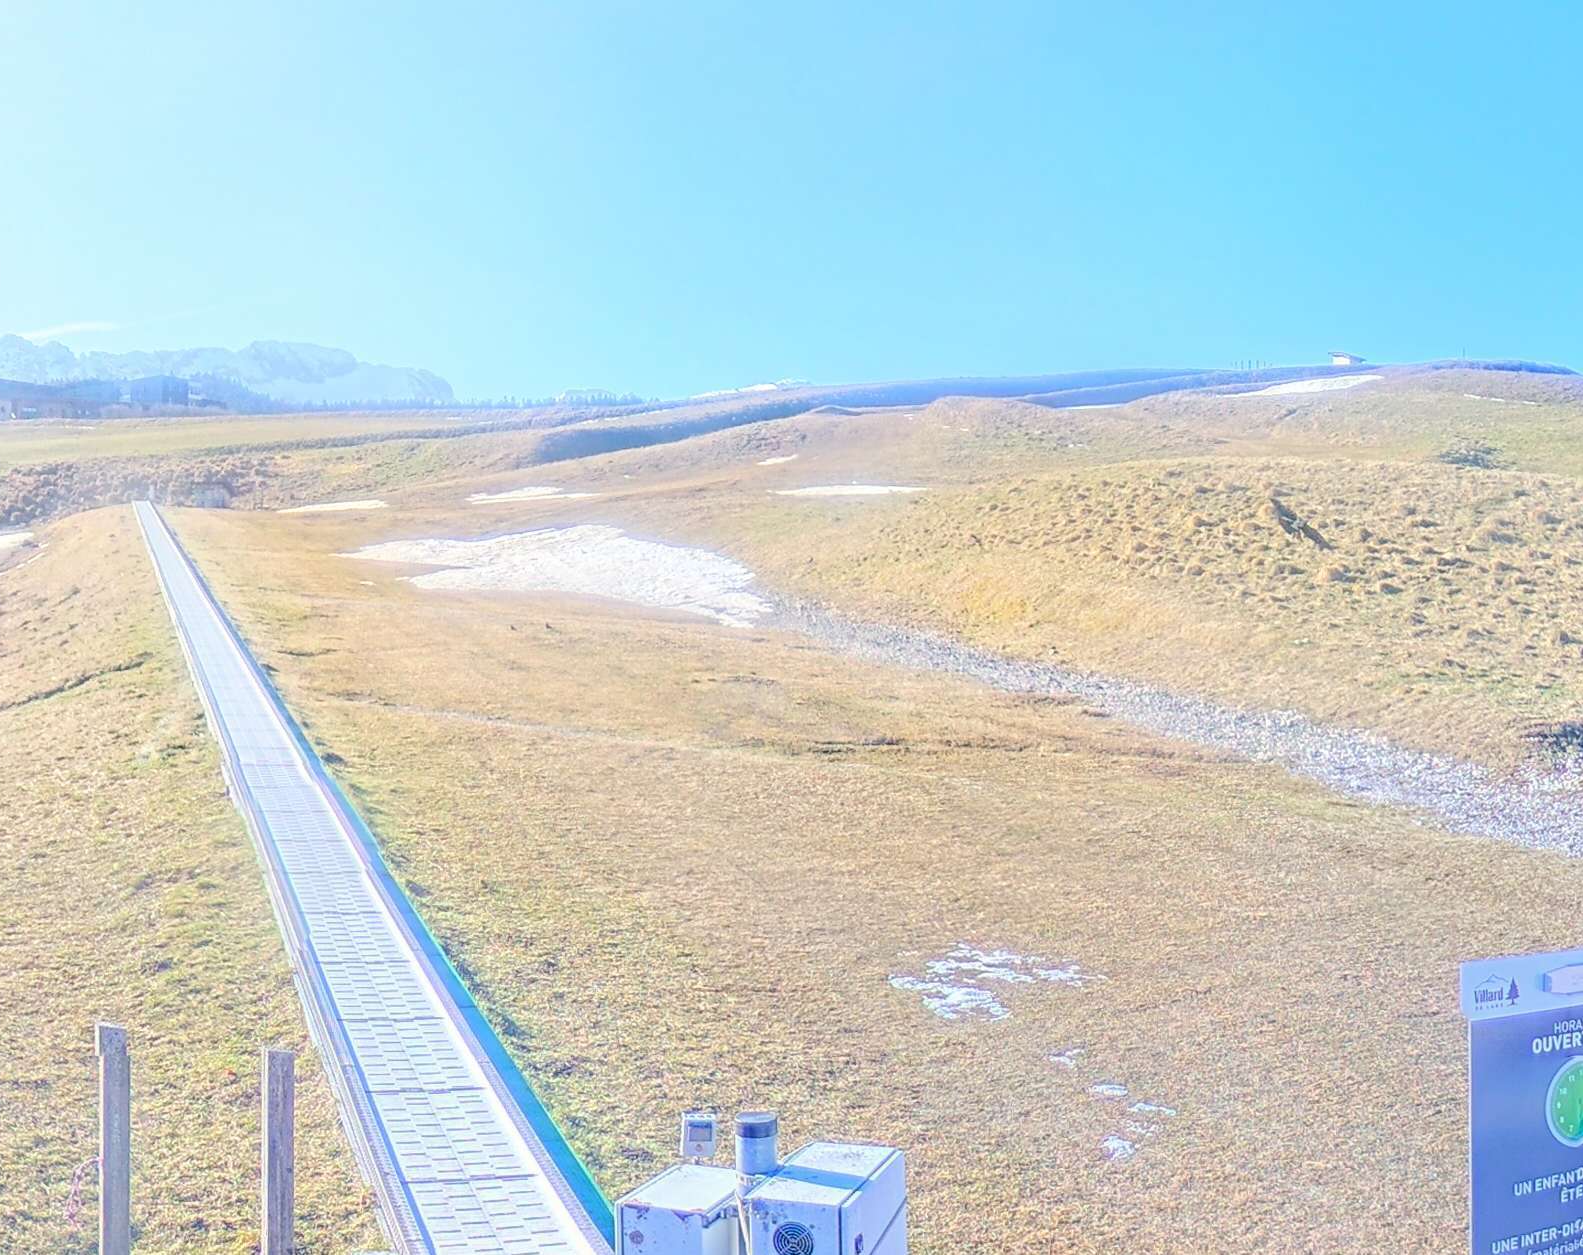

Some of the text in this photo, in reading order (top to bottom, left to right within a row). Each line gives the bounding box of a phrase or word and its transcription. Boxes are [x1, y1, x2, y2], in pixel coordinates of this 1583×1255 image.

[1473, 987, 1504, 1004] Villard
[1514, 1180, 1532, 1196] UN
[1492, 1236, 1519, 1254] UNE
